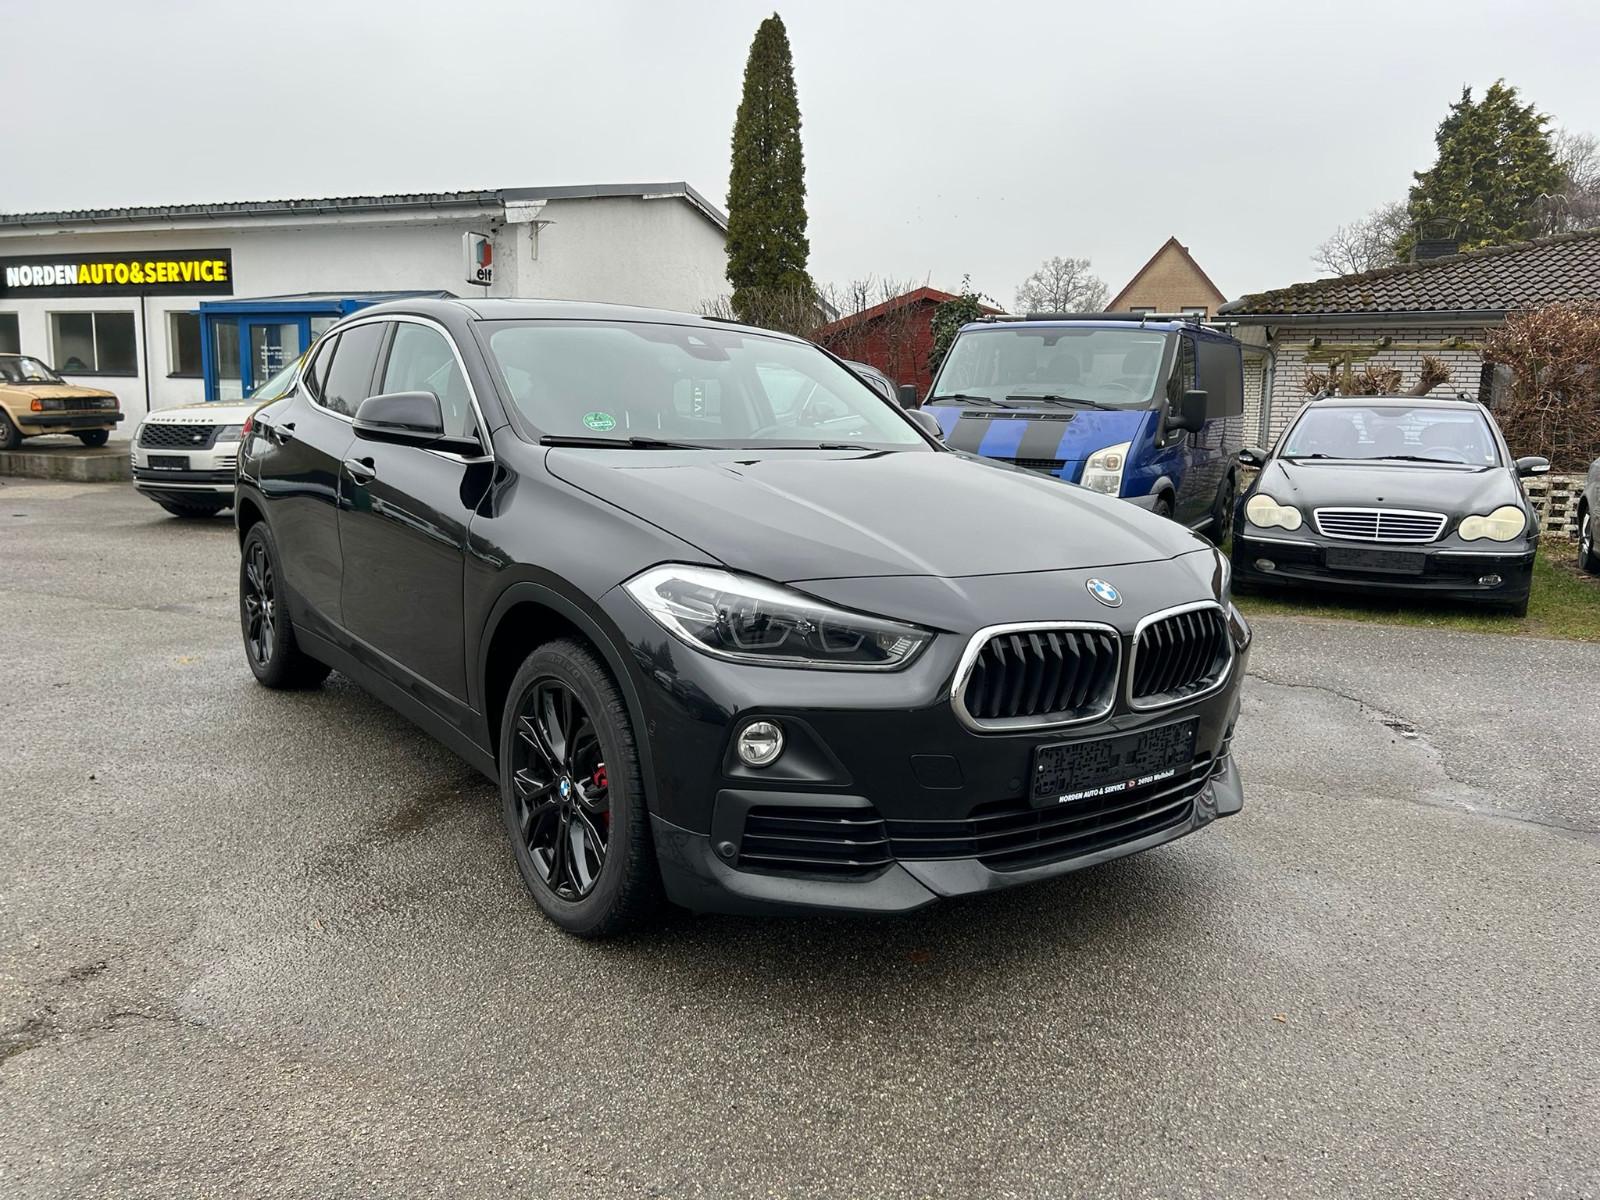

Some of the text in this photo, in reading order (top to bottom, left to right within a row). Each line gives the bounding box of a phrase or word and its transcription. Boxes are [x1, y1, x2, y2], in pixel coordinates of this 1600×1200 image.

[477, 268, 492, 281] elf
[1059, 792, 1083, 803] NORDEN
[1083, 789, 1099, 798] AUTO
[1099, 787, 1104, 795] &
[1104, 783, 1126, 794] SERVICE
